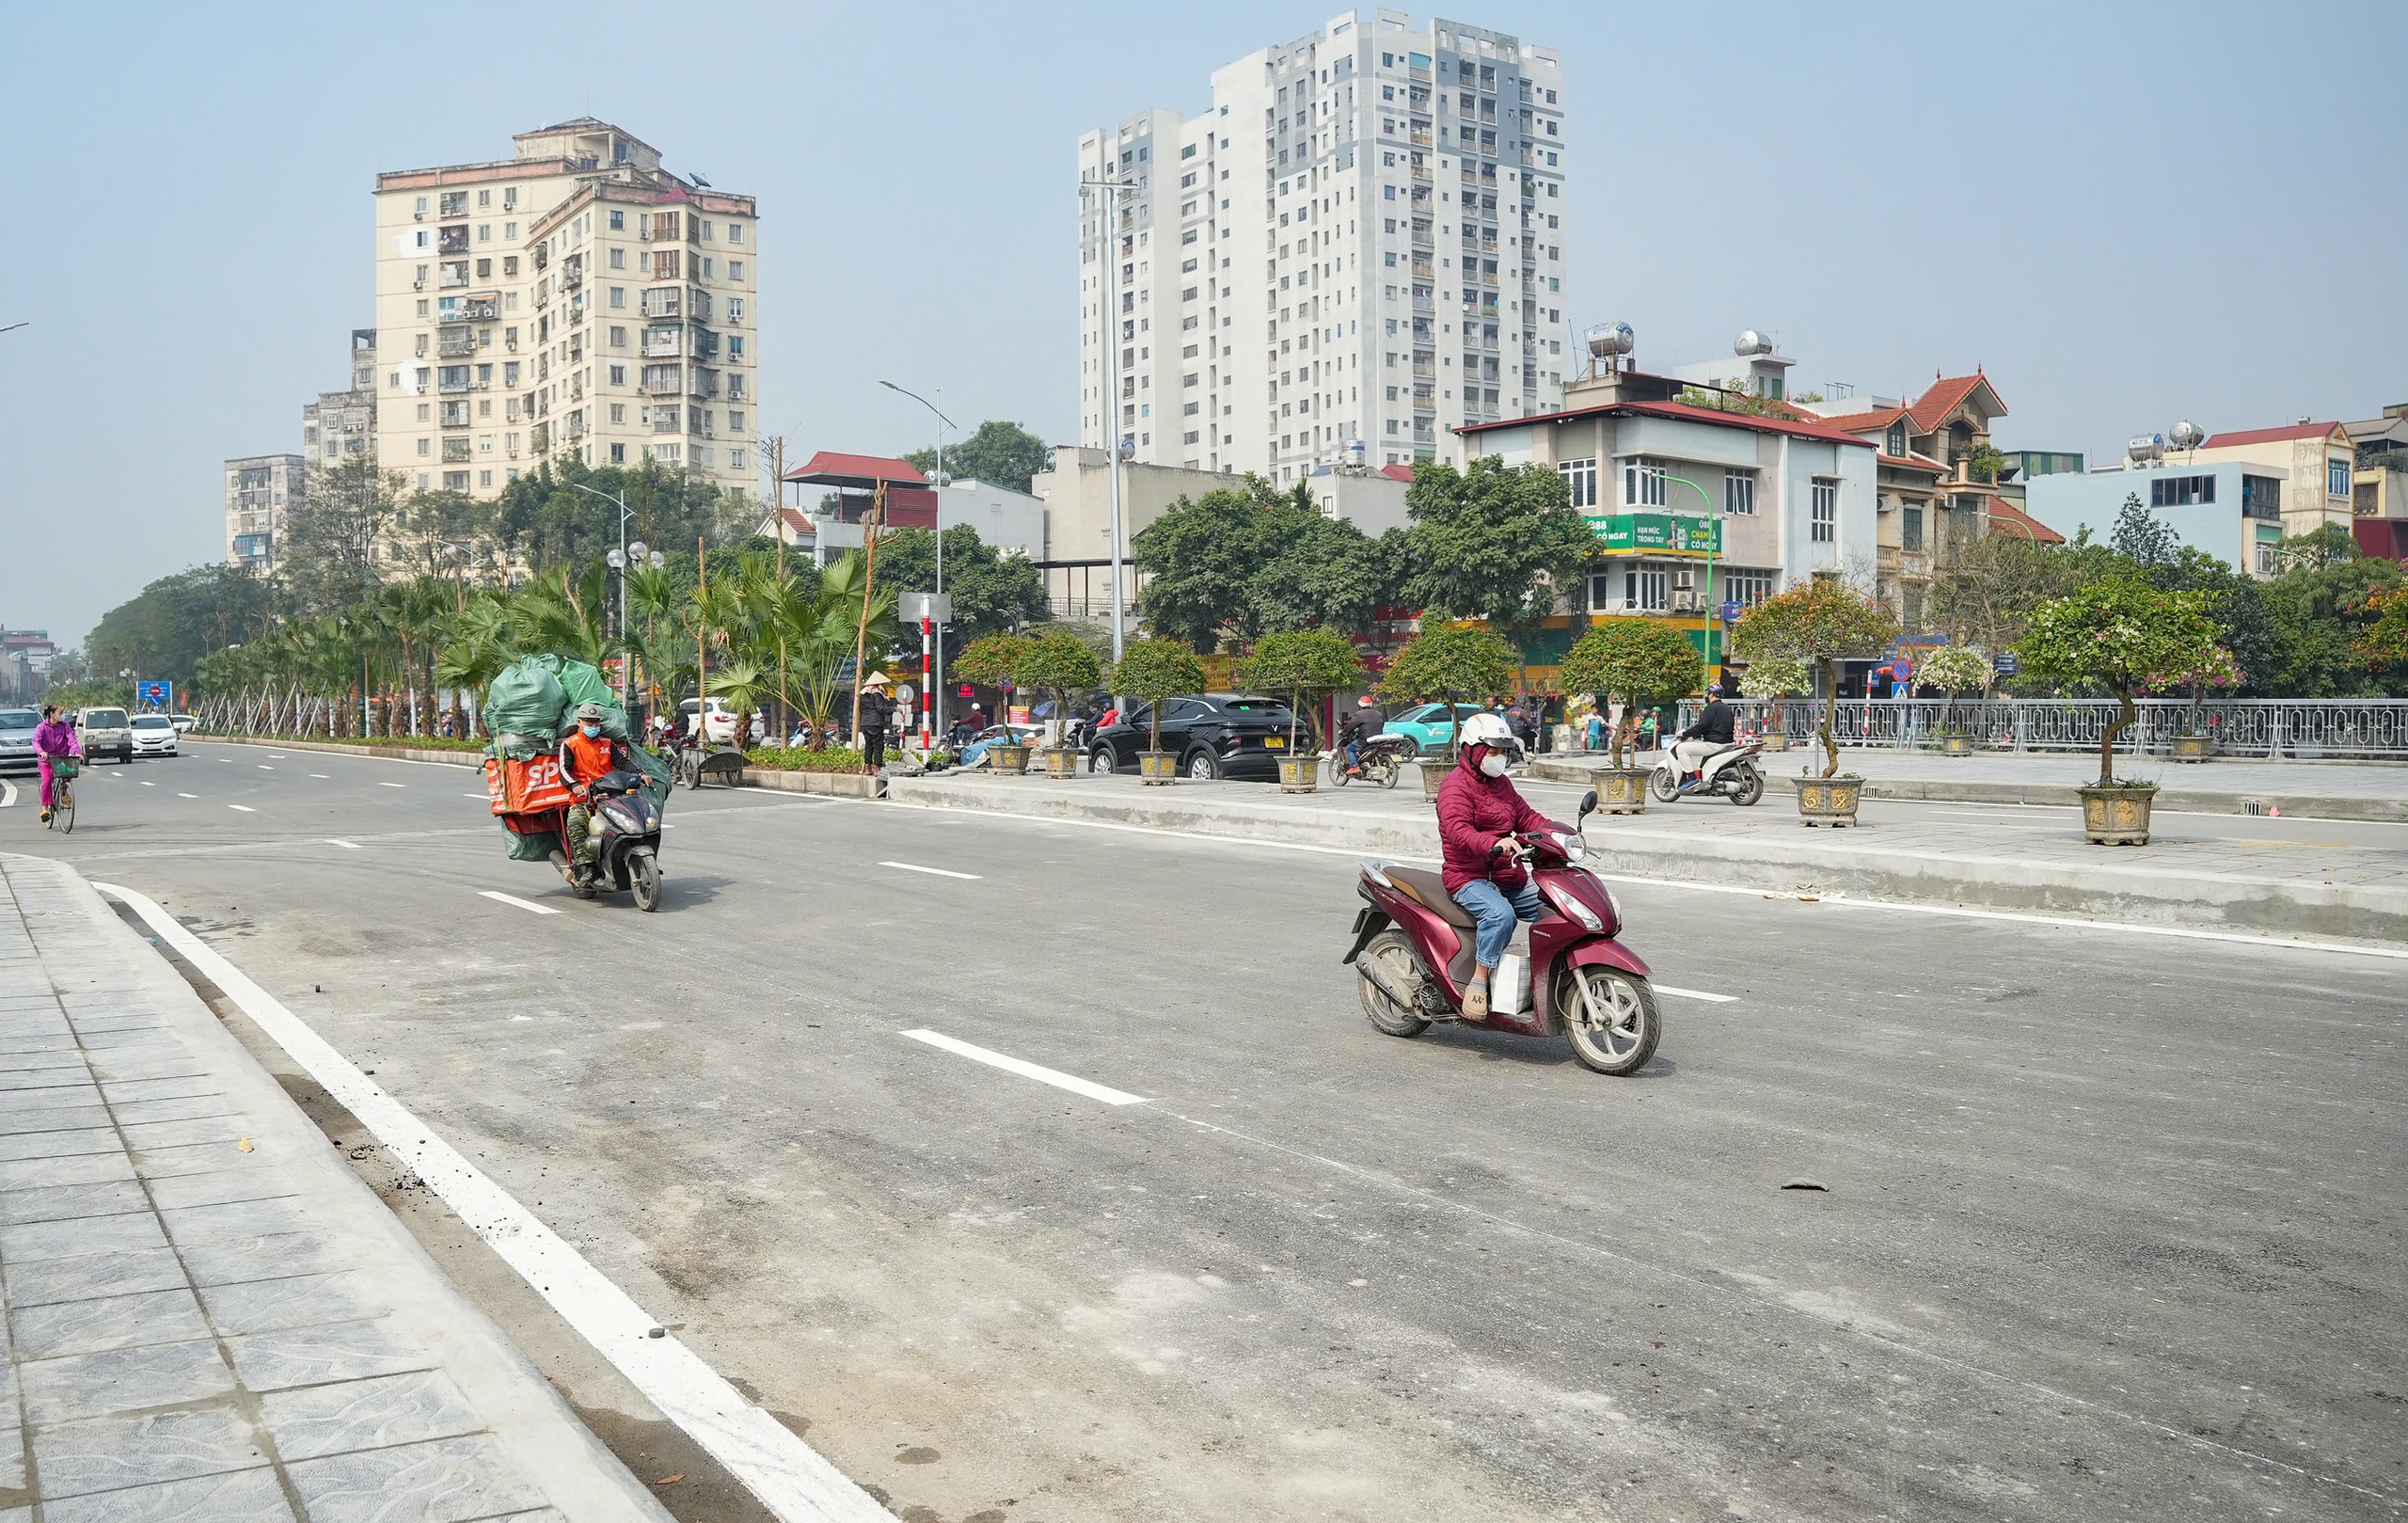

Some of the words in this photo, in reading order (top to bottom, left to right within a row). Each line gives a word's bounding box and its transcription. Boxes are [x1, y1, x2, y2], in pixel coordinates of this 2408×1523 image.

[1608, 531, 1628, 540] NGAY
[1638, 535, 1656, 544] TRONG
[1691, 539, 1700, 548] CÓ
[1533, 928, 1551, 938] HONDA
